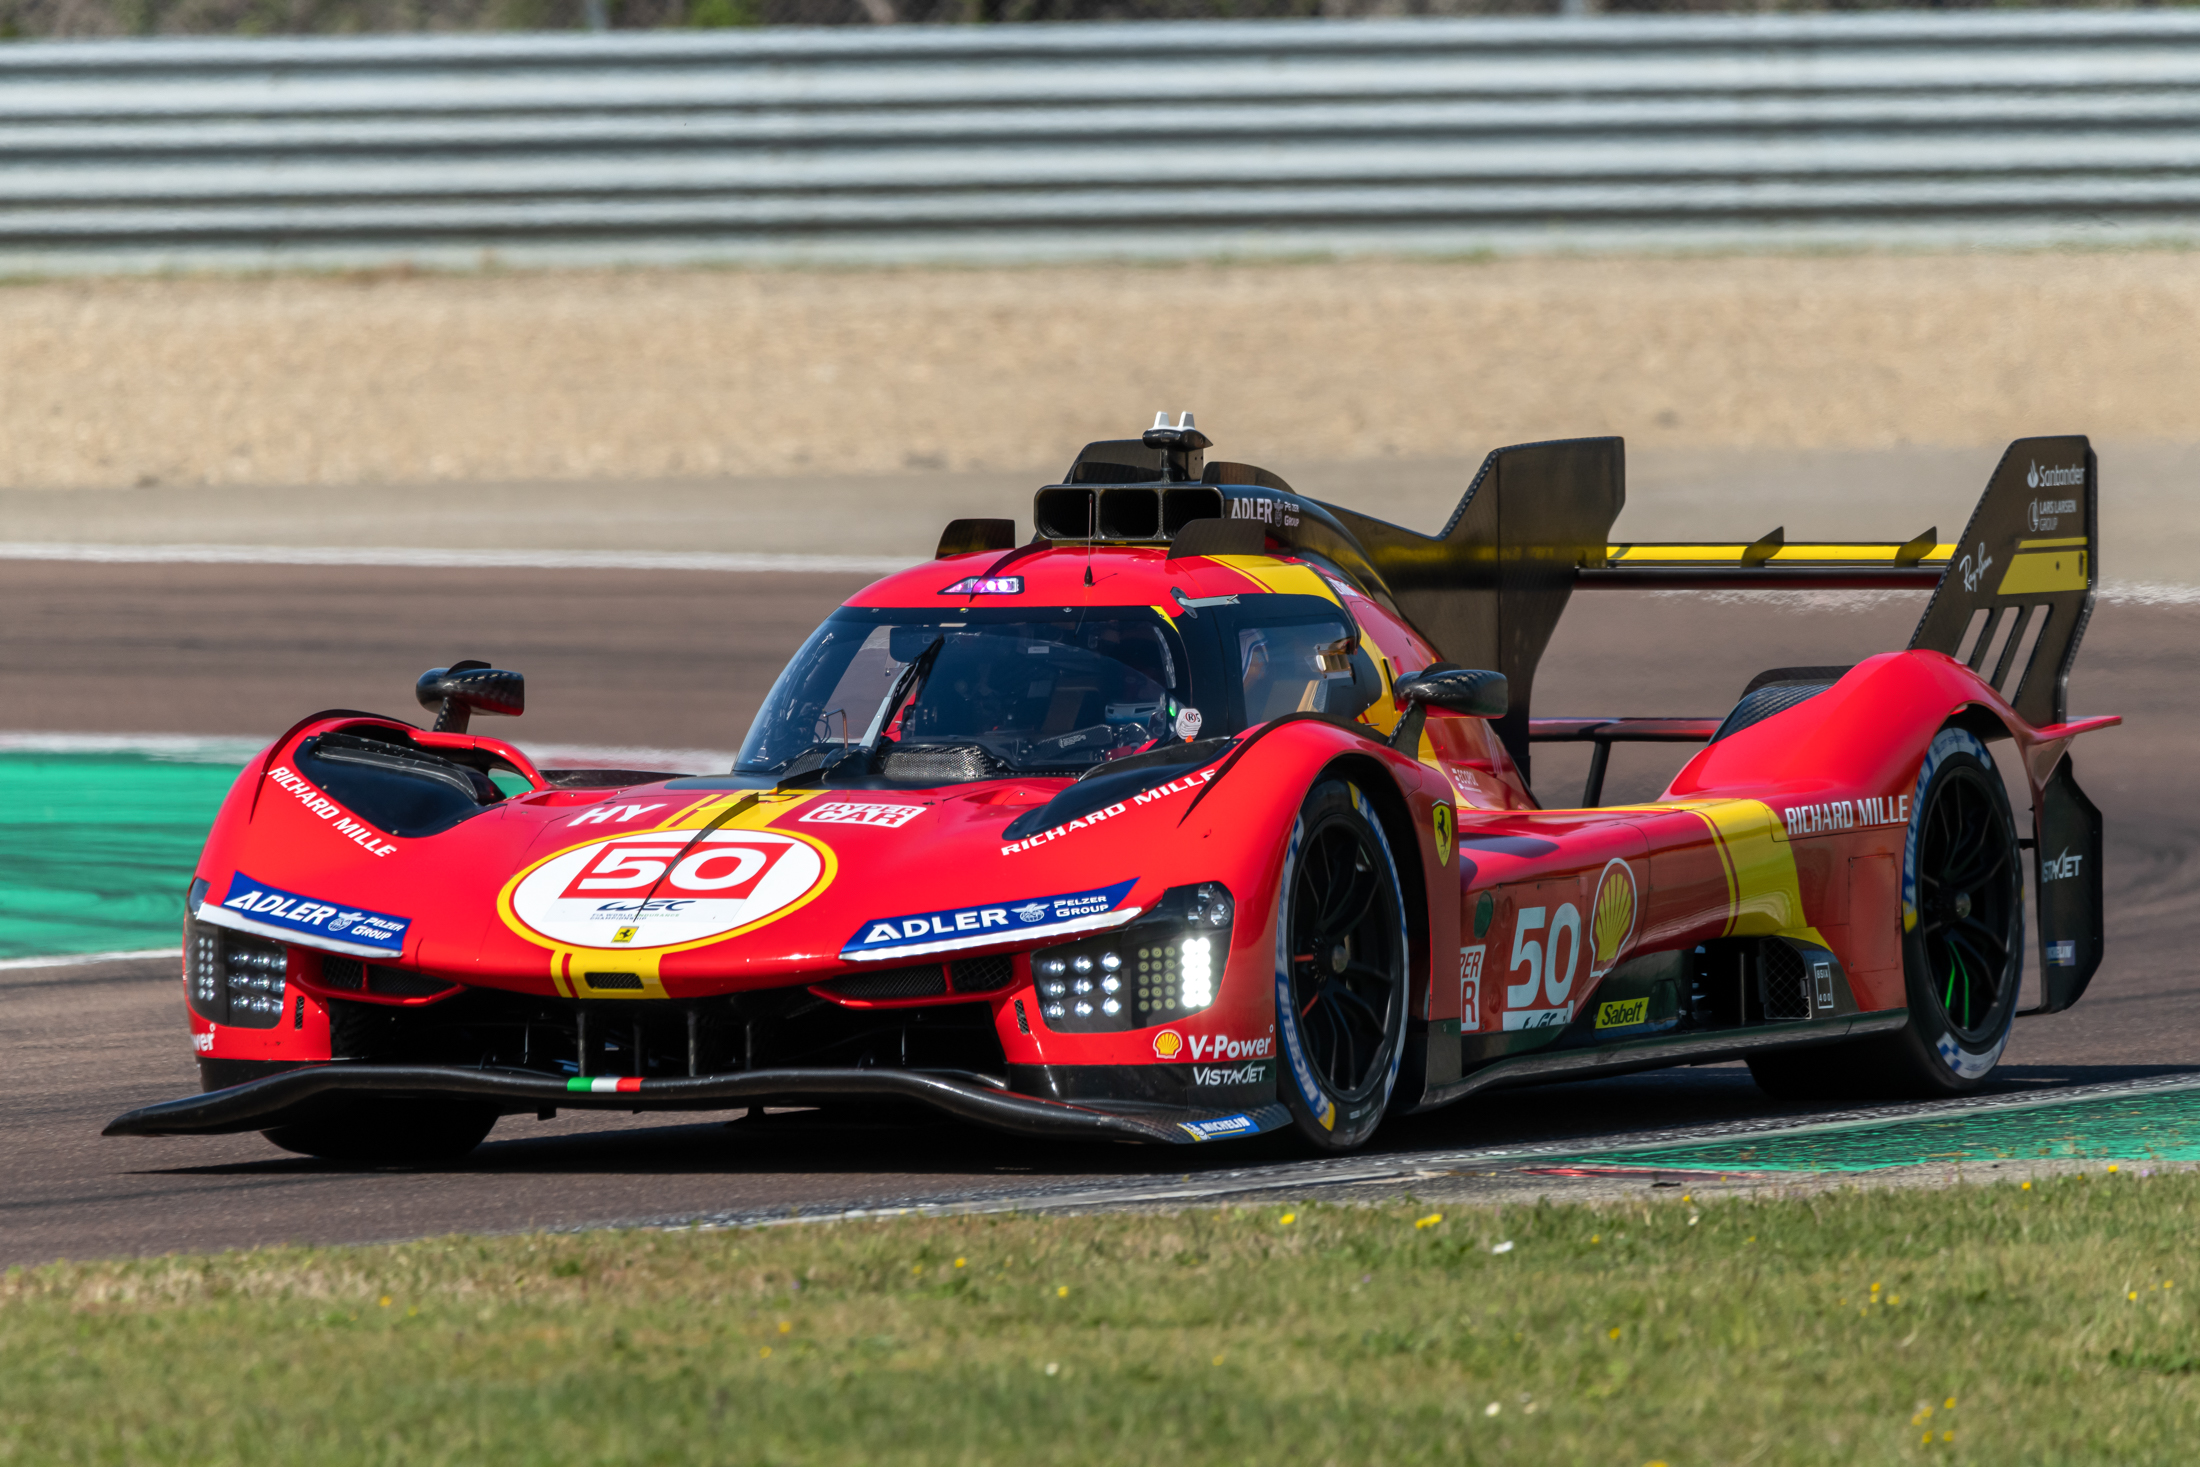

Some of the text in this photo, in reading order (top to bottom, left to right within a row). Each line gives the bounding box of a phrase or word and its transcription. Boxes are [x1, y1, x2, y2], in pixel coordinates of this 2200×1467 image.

[2039, 463, 2085, 487] Santander
[1230, 498, 1273, 524] ADLER
[2039, 499, 2077, 515] LARS LARSEN
[2039, 517, 2058, 532] GROUP
[268, 766, 398, 858] RICHARD MILLE
[566, 803, 669, 828] HY
[808, 810, 906, 825] CAR
[822, 803, 919, 815] HYPER
[1785, 795, 1909, 836] RICHARD MILLE
[1001, 801, 1127, 857] RICHARD
[577, 847, 768, 890] 50
[223, 890, 338, 927] ADLER
[1053, 895, 1108, 908] PELZER
[1055, 903, 1110, 918] GROUP
[350, 925, 393, 941] GROUP
[363, 915, 406, 933] PELZER
[863, 908, 1009, 944] ADLER
[1506, 902, 1582, 1008] 50
[1601, 1002, 1643, 1026] Sabelt
[1187, 1033, 1272, 1060] V-Power
[1277, 981, 1319, 1103] MICHELIN
[1199, 1116, 1251, 1133] MICHELIN
